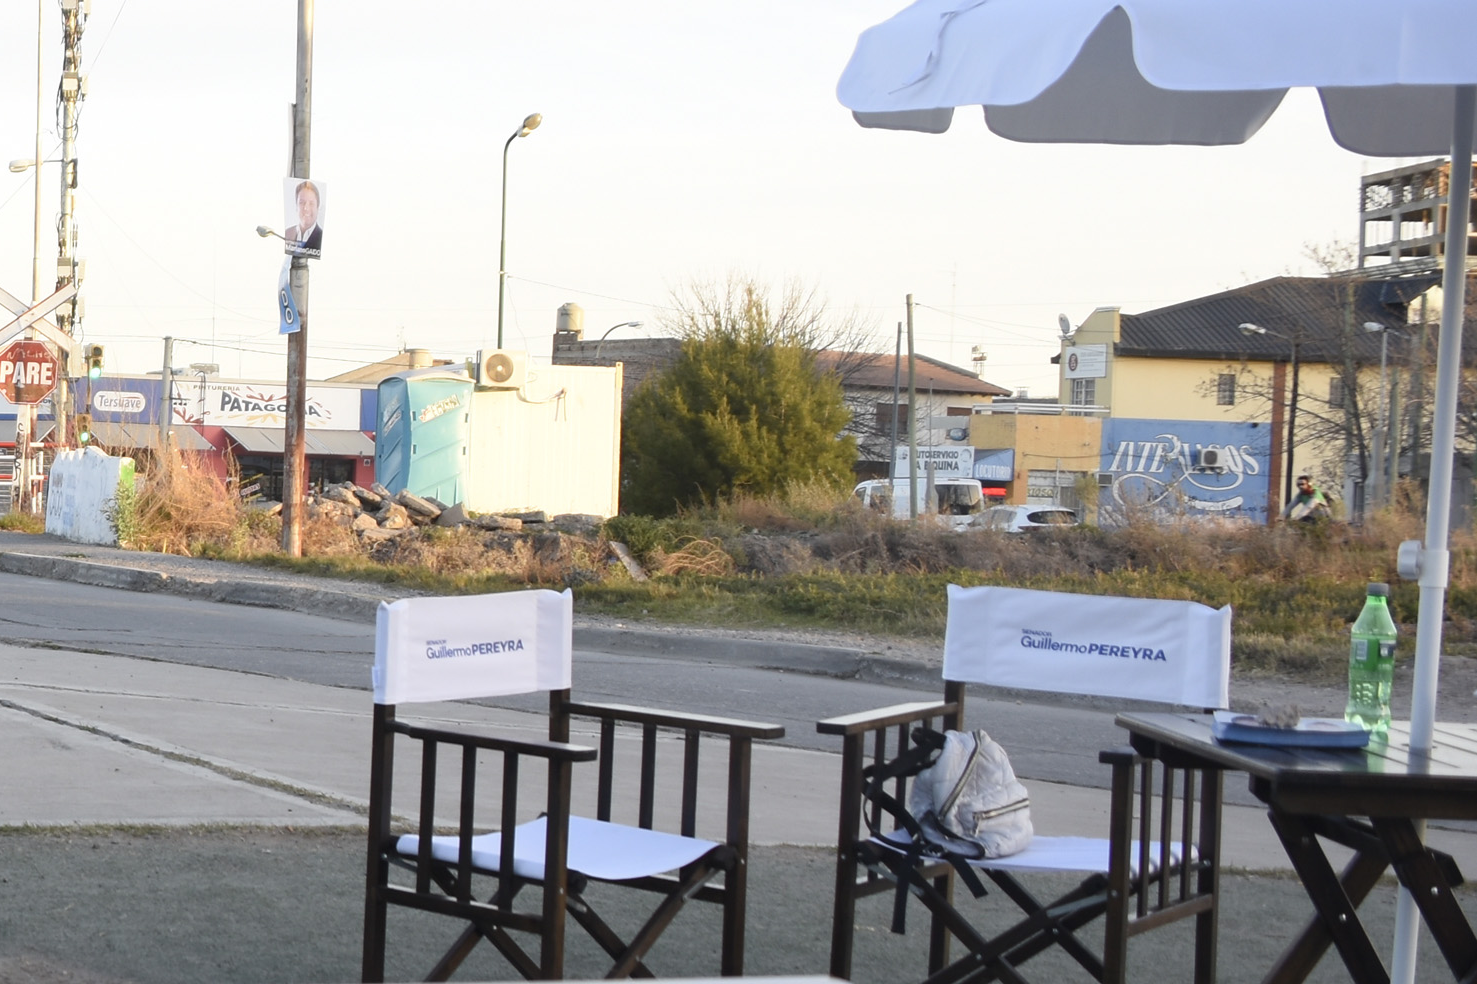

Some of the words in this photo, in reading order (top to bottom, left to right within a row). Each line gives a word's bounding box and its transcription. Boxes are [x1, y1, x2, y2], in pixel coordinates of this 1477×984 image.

[0, 360, 53, 385] PARE
[98, 395, 141, 408] Tersuave
[916, 450, 959, 459] UTOSERVICIO
[924, 460, 960, 471] EQUINA
